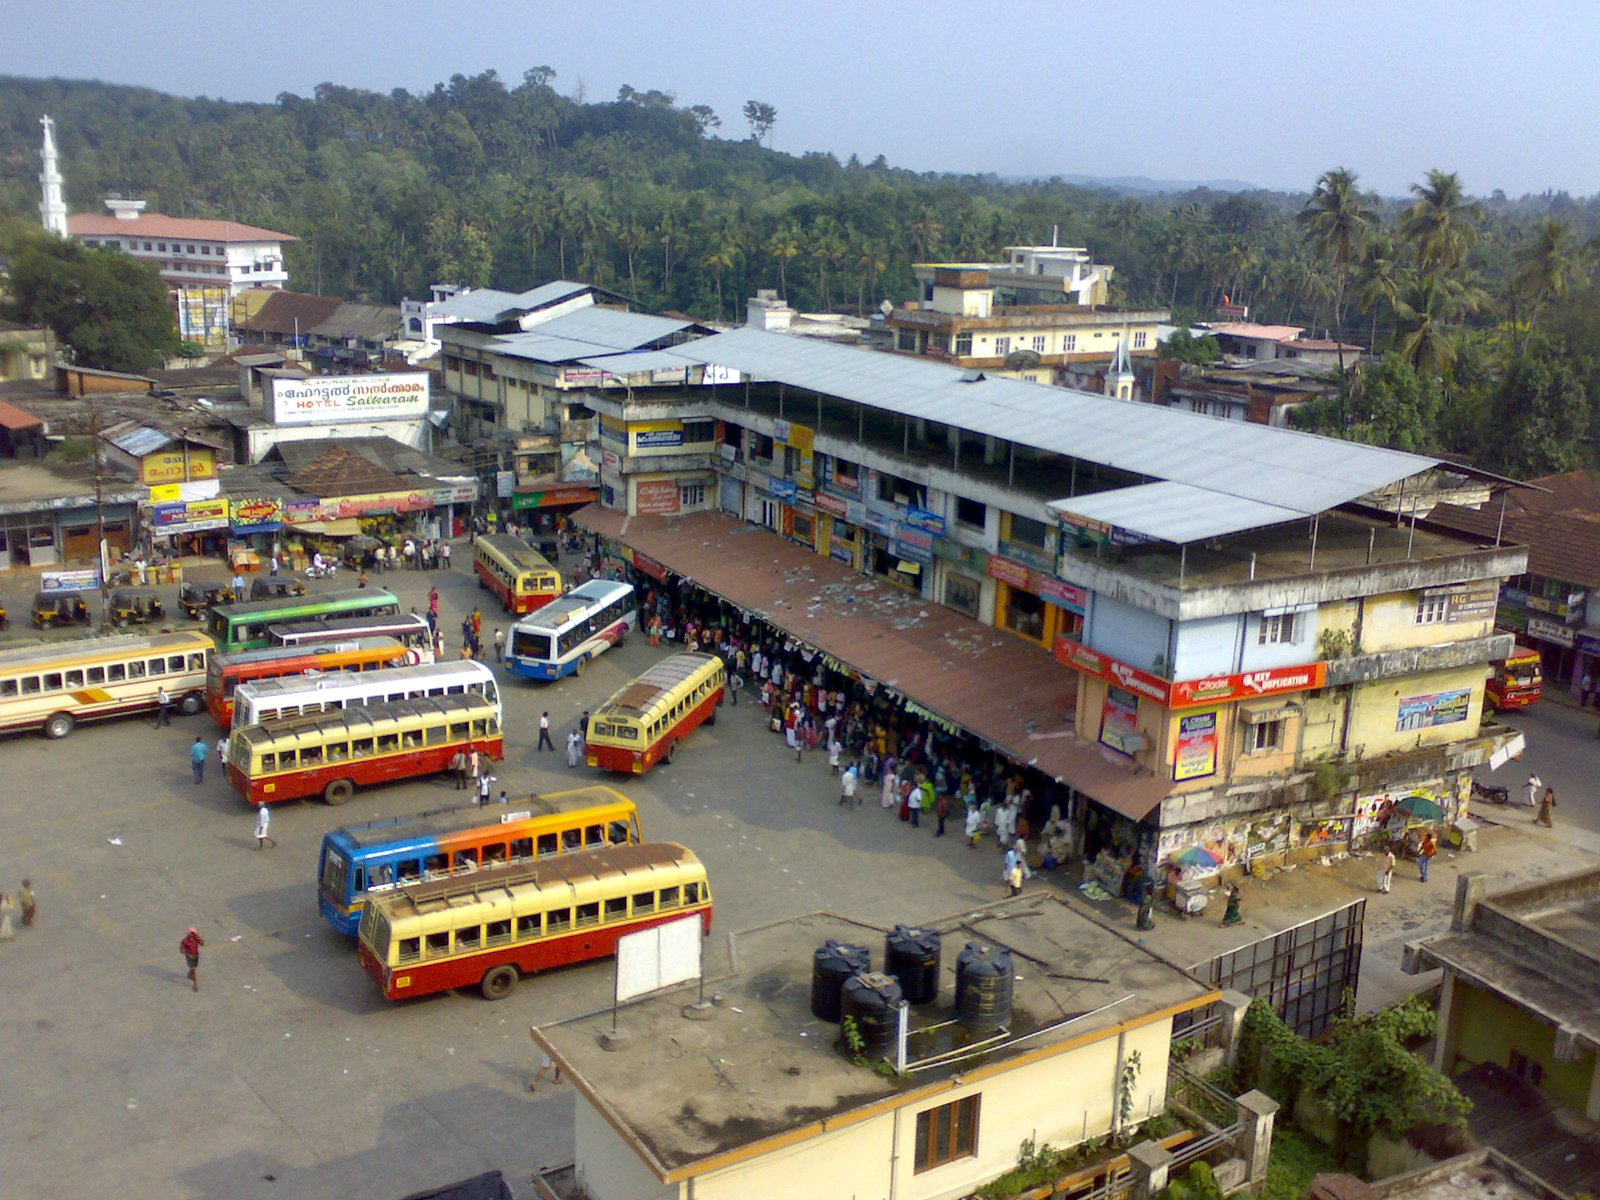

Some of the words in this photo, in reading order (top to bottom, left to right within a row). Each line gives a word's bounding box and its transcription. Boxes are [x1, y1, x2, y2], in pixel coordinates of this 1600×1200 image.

[296, 399, 341, 409] HOTEL
[1119, 665, 1134, 678] KEY
[1254, 672, 1272, 682] KEY
[1198, 678, 1229, 691] Citadel
[1261, 675, 1309, 689] DUPLICATION
